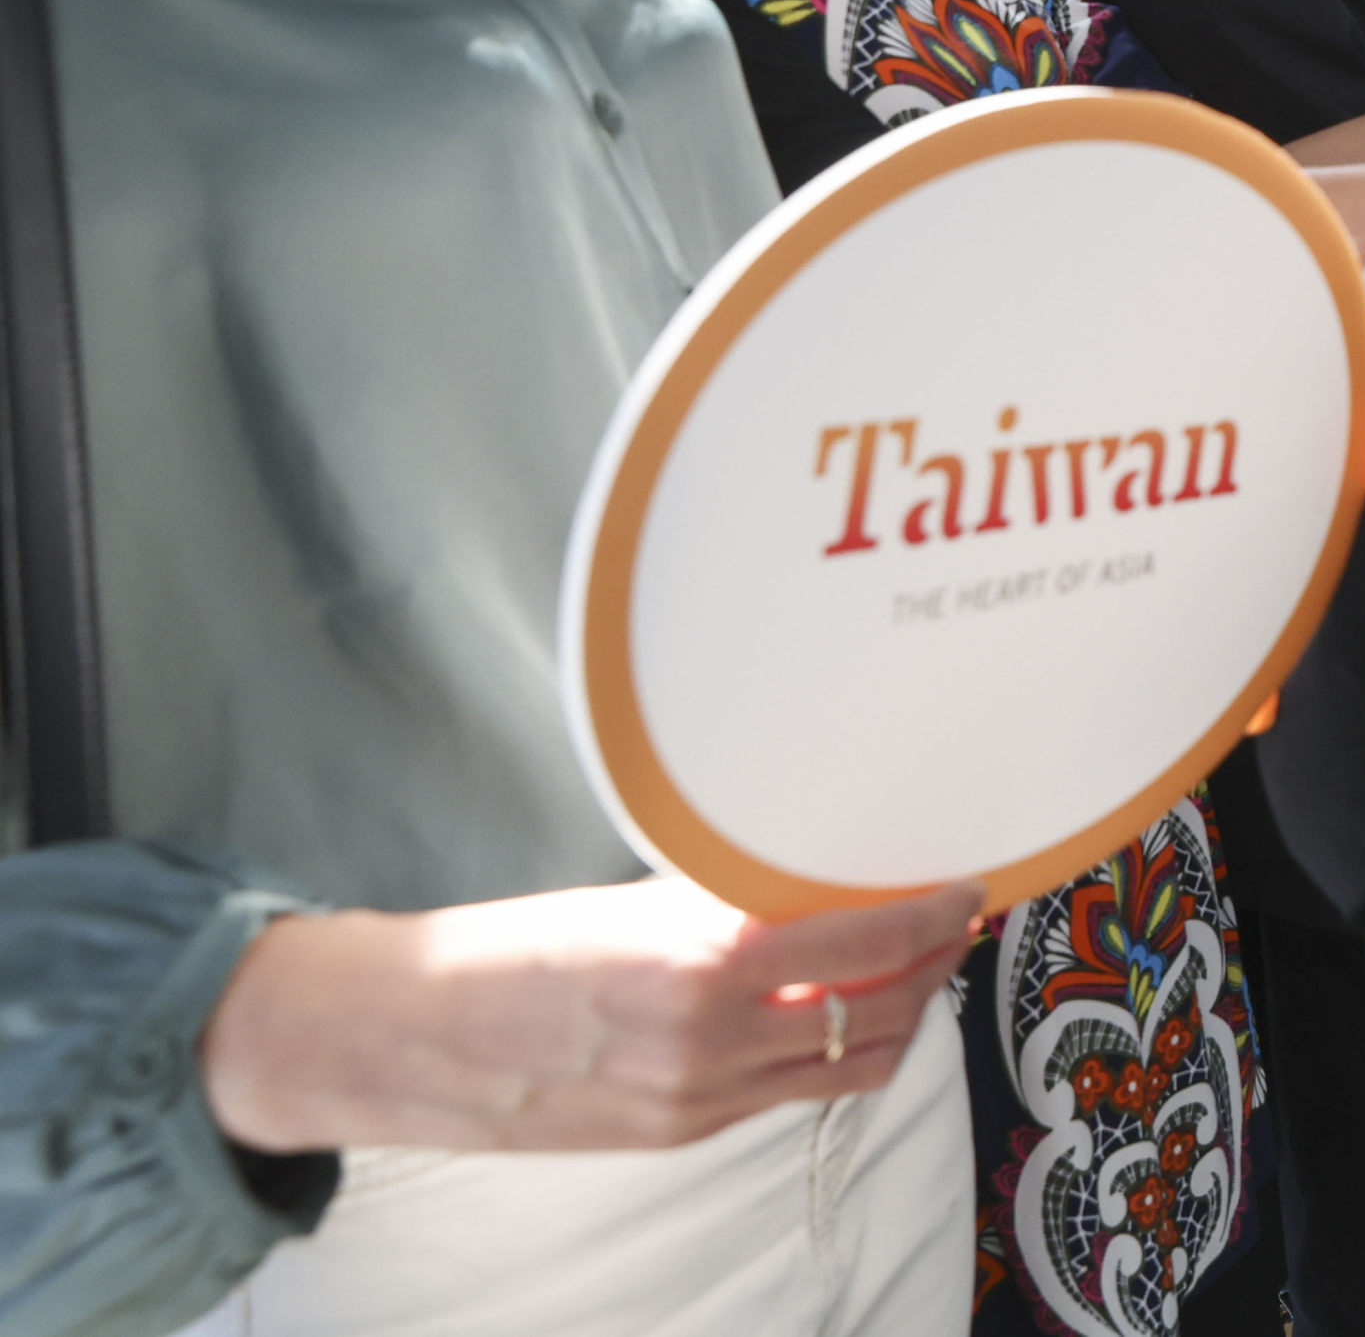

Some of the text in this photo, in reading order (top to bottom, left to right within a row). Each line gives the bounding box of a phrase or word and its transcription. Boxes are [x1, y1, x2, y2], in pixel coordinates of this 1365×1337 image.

[813, 404, 1240, 559] Taiwan
[892, 551, 1159, 626] THE HEART OF ASIA
